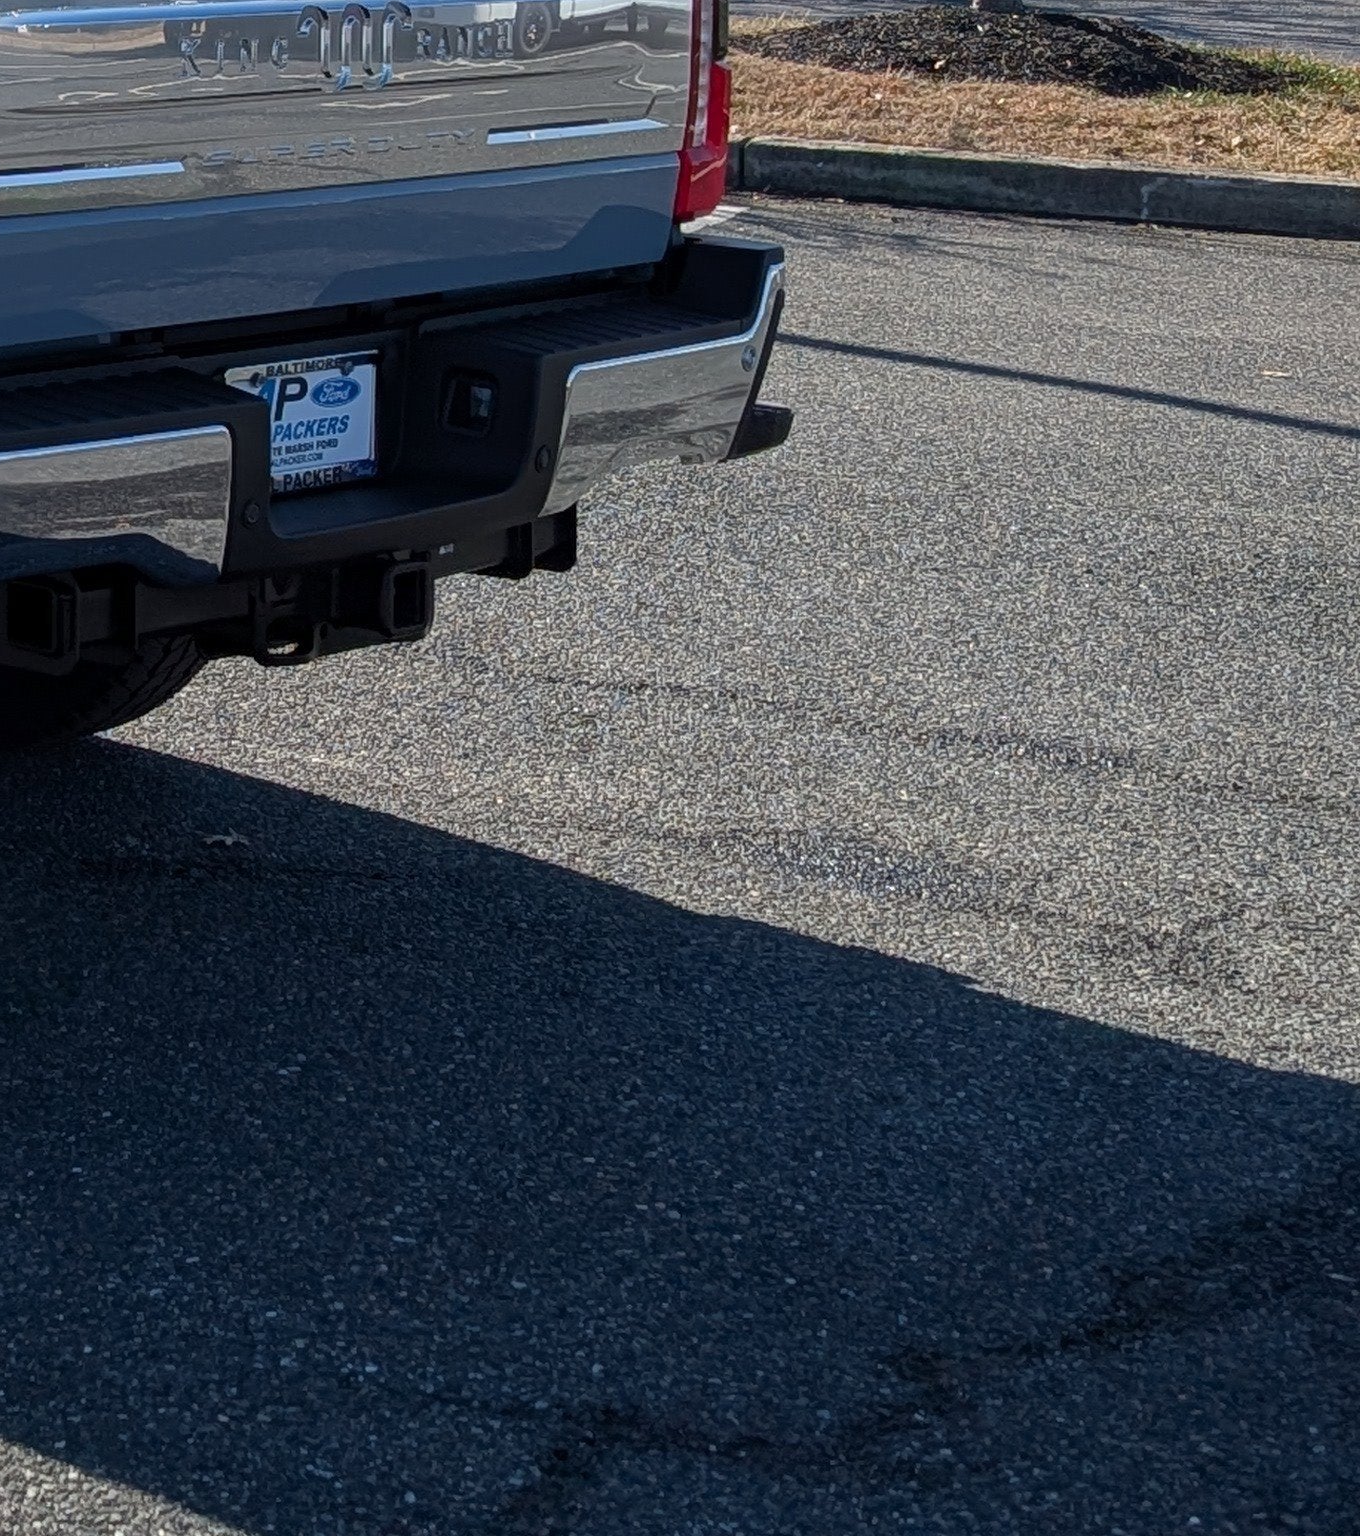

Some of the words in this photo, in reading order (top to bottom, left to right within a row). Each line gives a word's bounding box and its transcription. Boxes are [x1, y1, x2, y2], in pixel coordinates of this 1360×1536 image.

[179, 37, 288, 76] KING
[416, 19, 516, 60] RANCH
[320, 381, 351, 402] Ford
[272, 414, 349, 442] PACKERS
[283, 465, 341, 492] PACKER
